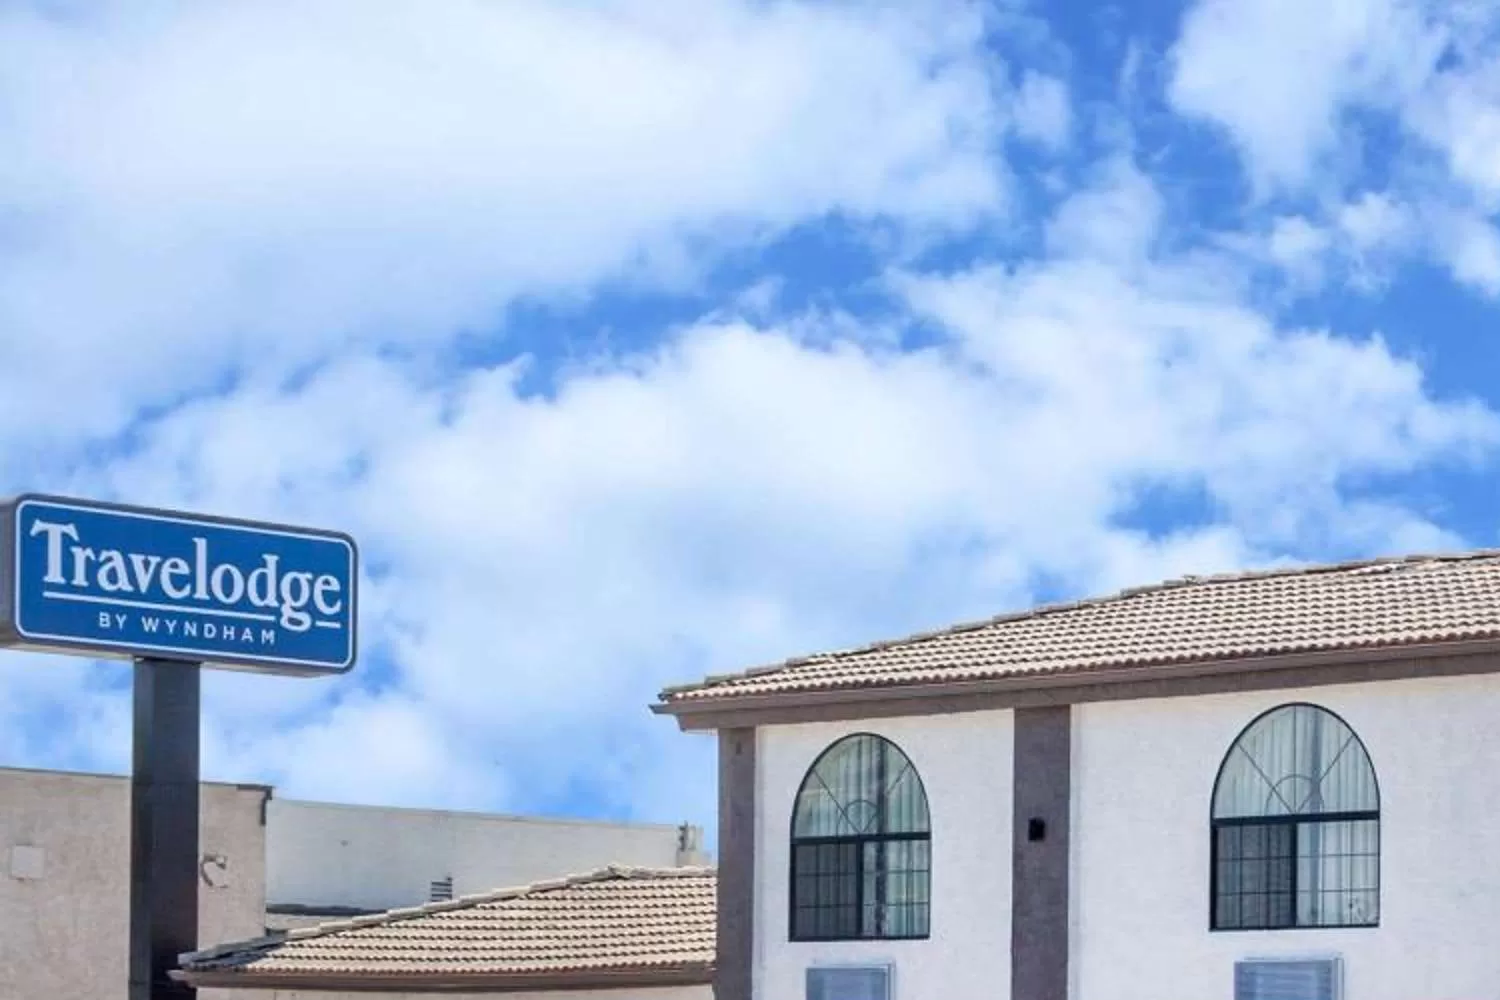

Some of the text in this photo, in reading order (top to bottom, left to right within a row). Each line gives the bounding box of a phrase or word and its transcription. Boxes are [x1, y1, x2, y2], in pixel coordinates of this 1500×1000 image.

[30, 519, 342, 632] Travelodge
[99, 612, 276, 645] BY WYNDHAM
